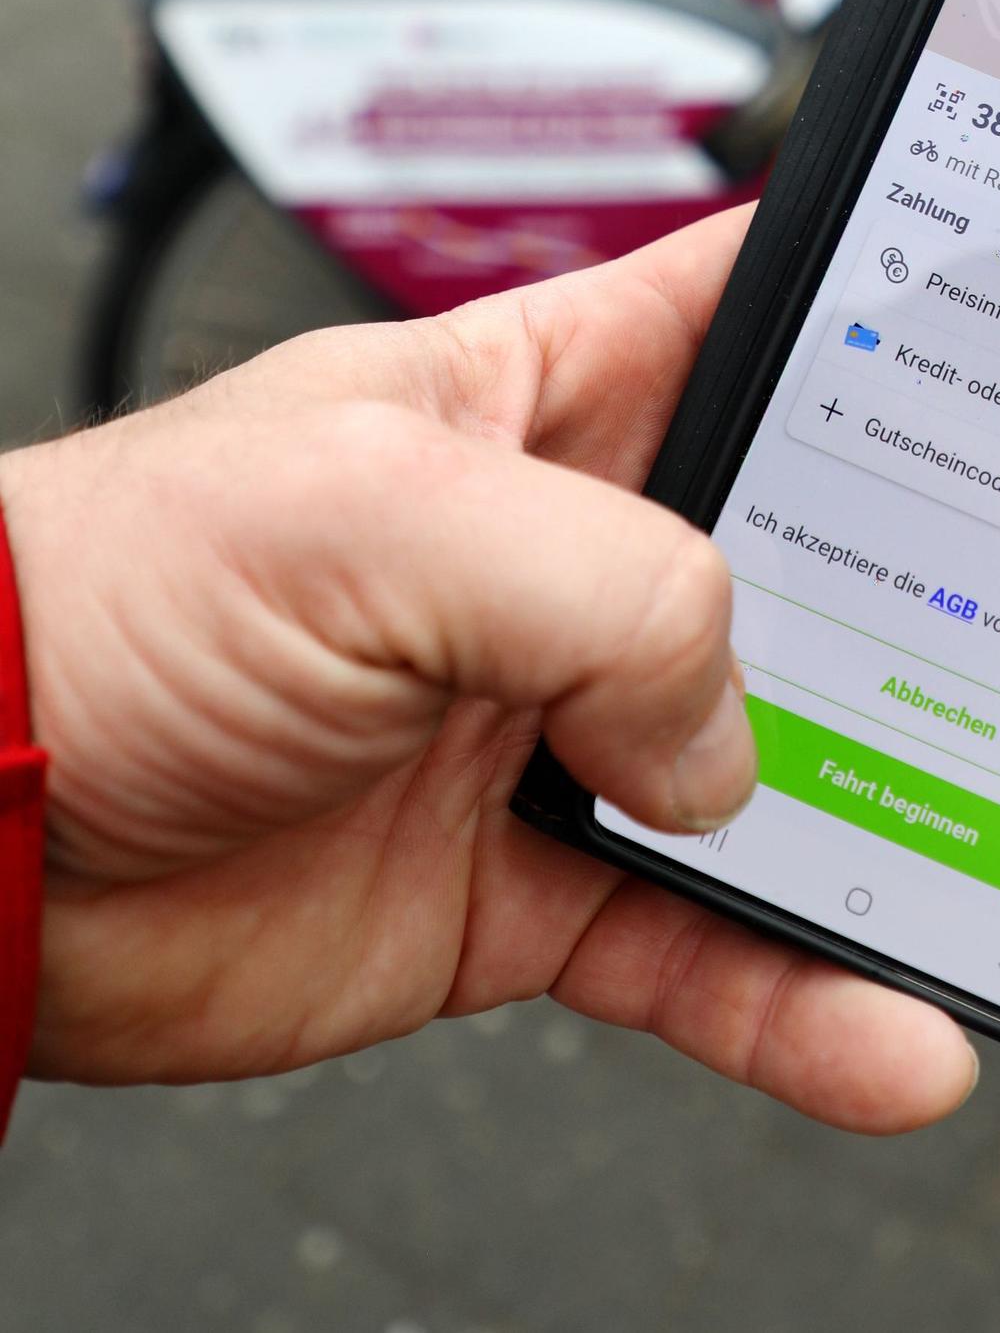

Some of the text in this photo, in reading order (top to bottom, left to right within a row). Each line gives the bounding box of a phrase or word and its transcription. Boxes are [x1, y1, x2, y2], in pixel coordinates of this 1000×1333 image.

[944, 155, 981, 180] mit
[886, 182, 971, 235] Zahlung
[894, 344, 963, 386] Kredit-
[745, 505, 779, 535] Ich
[782, 525, 889, 583] akzeptiere
[893, 571, 926, 598] die
[927, 587, 979, 623] AGB
[879, 676, 998, 741] Abbrechen
[818, 759, 980, 847] Fahrt beginnen
